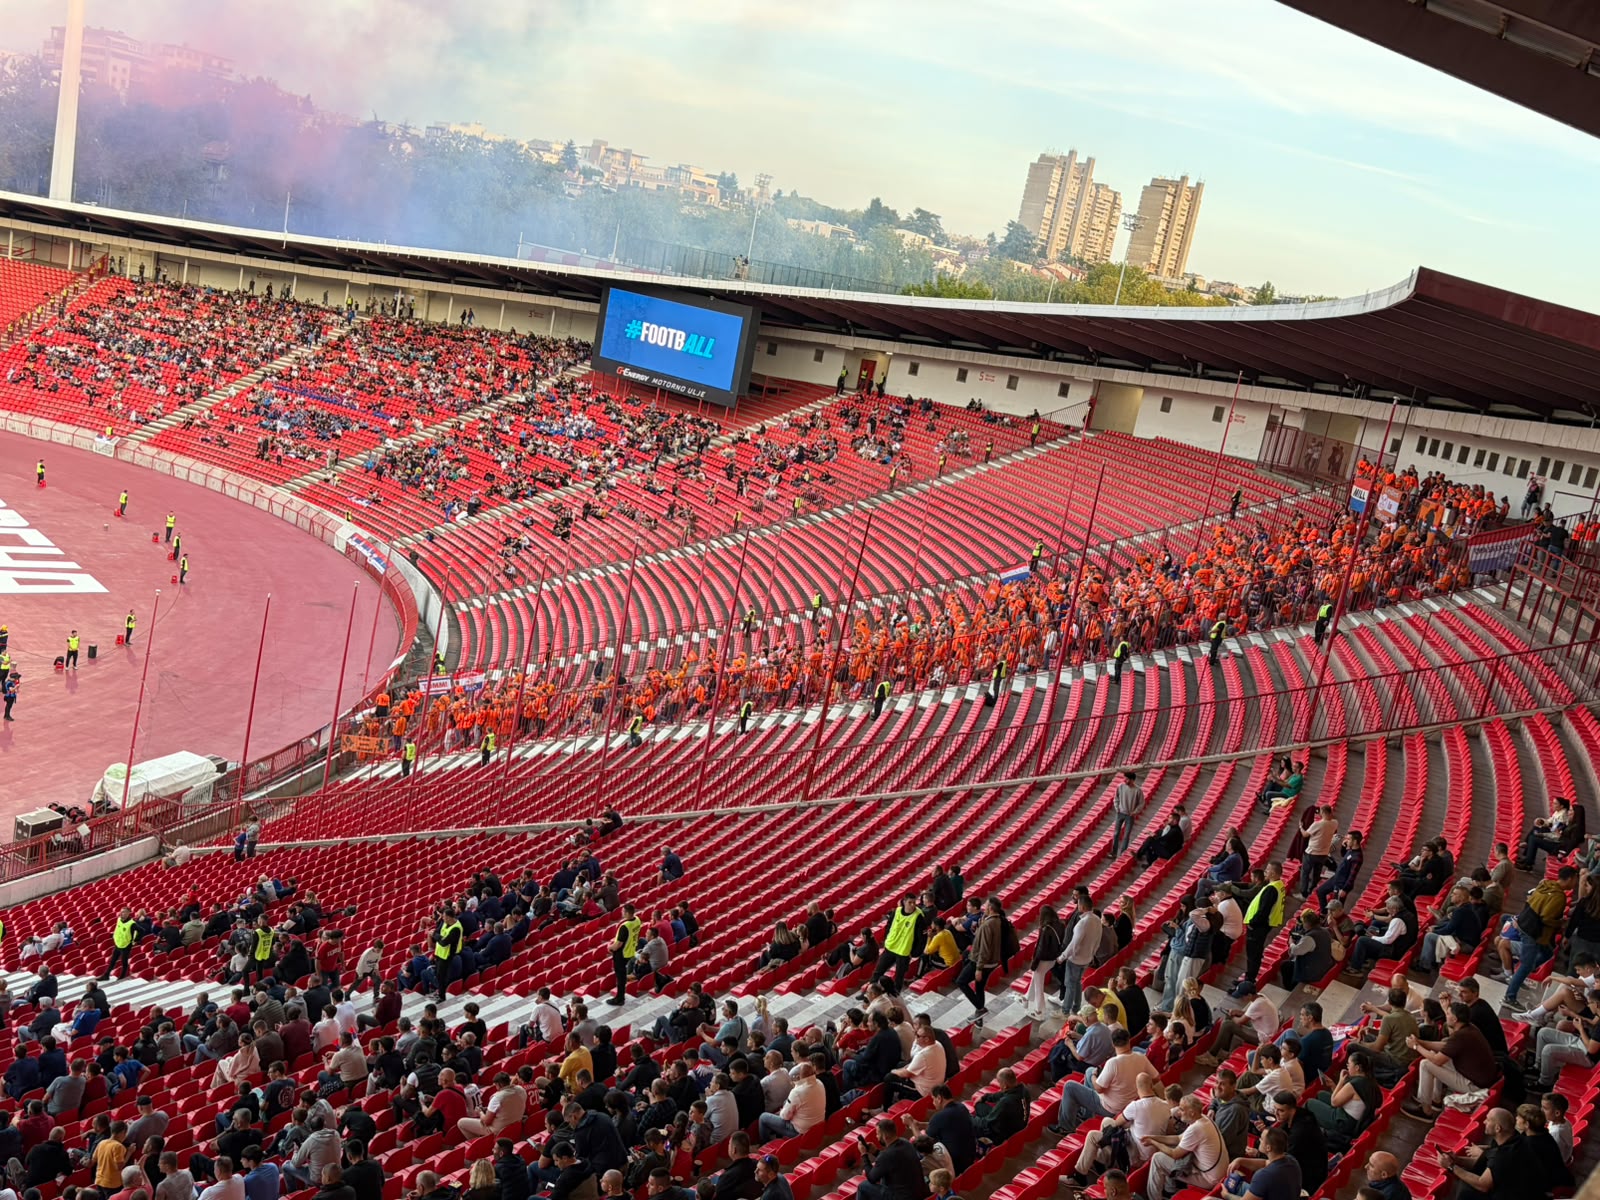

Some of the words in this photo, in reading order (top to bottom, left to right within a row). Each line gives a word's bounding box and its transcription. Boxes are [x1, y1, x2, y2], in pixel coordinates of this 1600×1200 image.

[624, 319, 716, 359] #FOOTBALL
[651, 378, 687, 393] MOTORNO
[687, 387, 706, 398] ULJE
